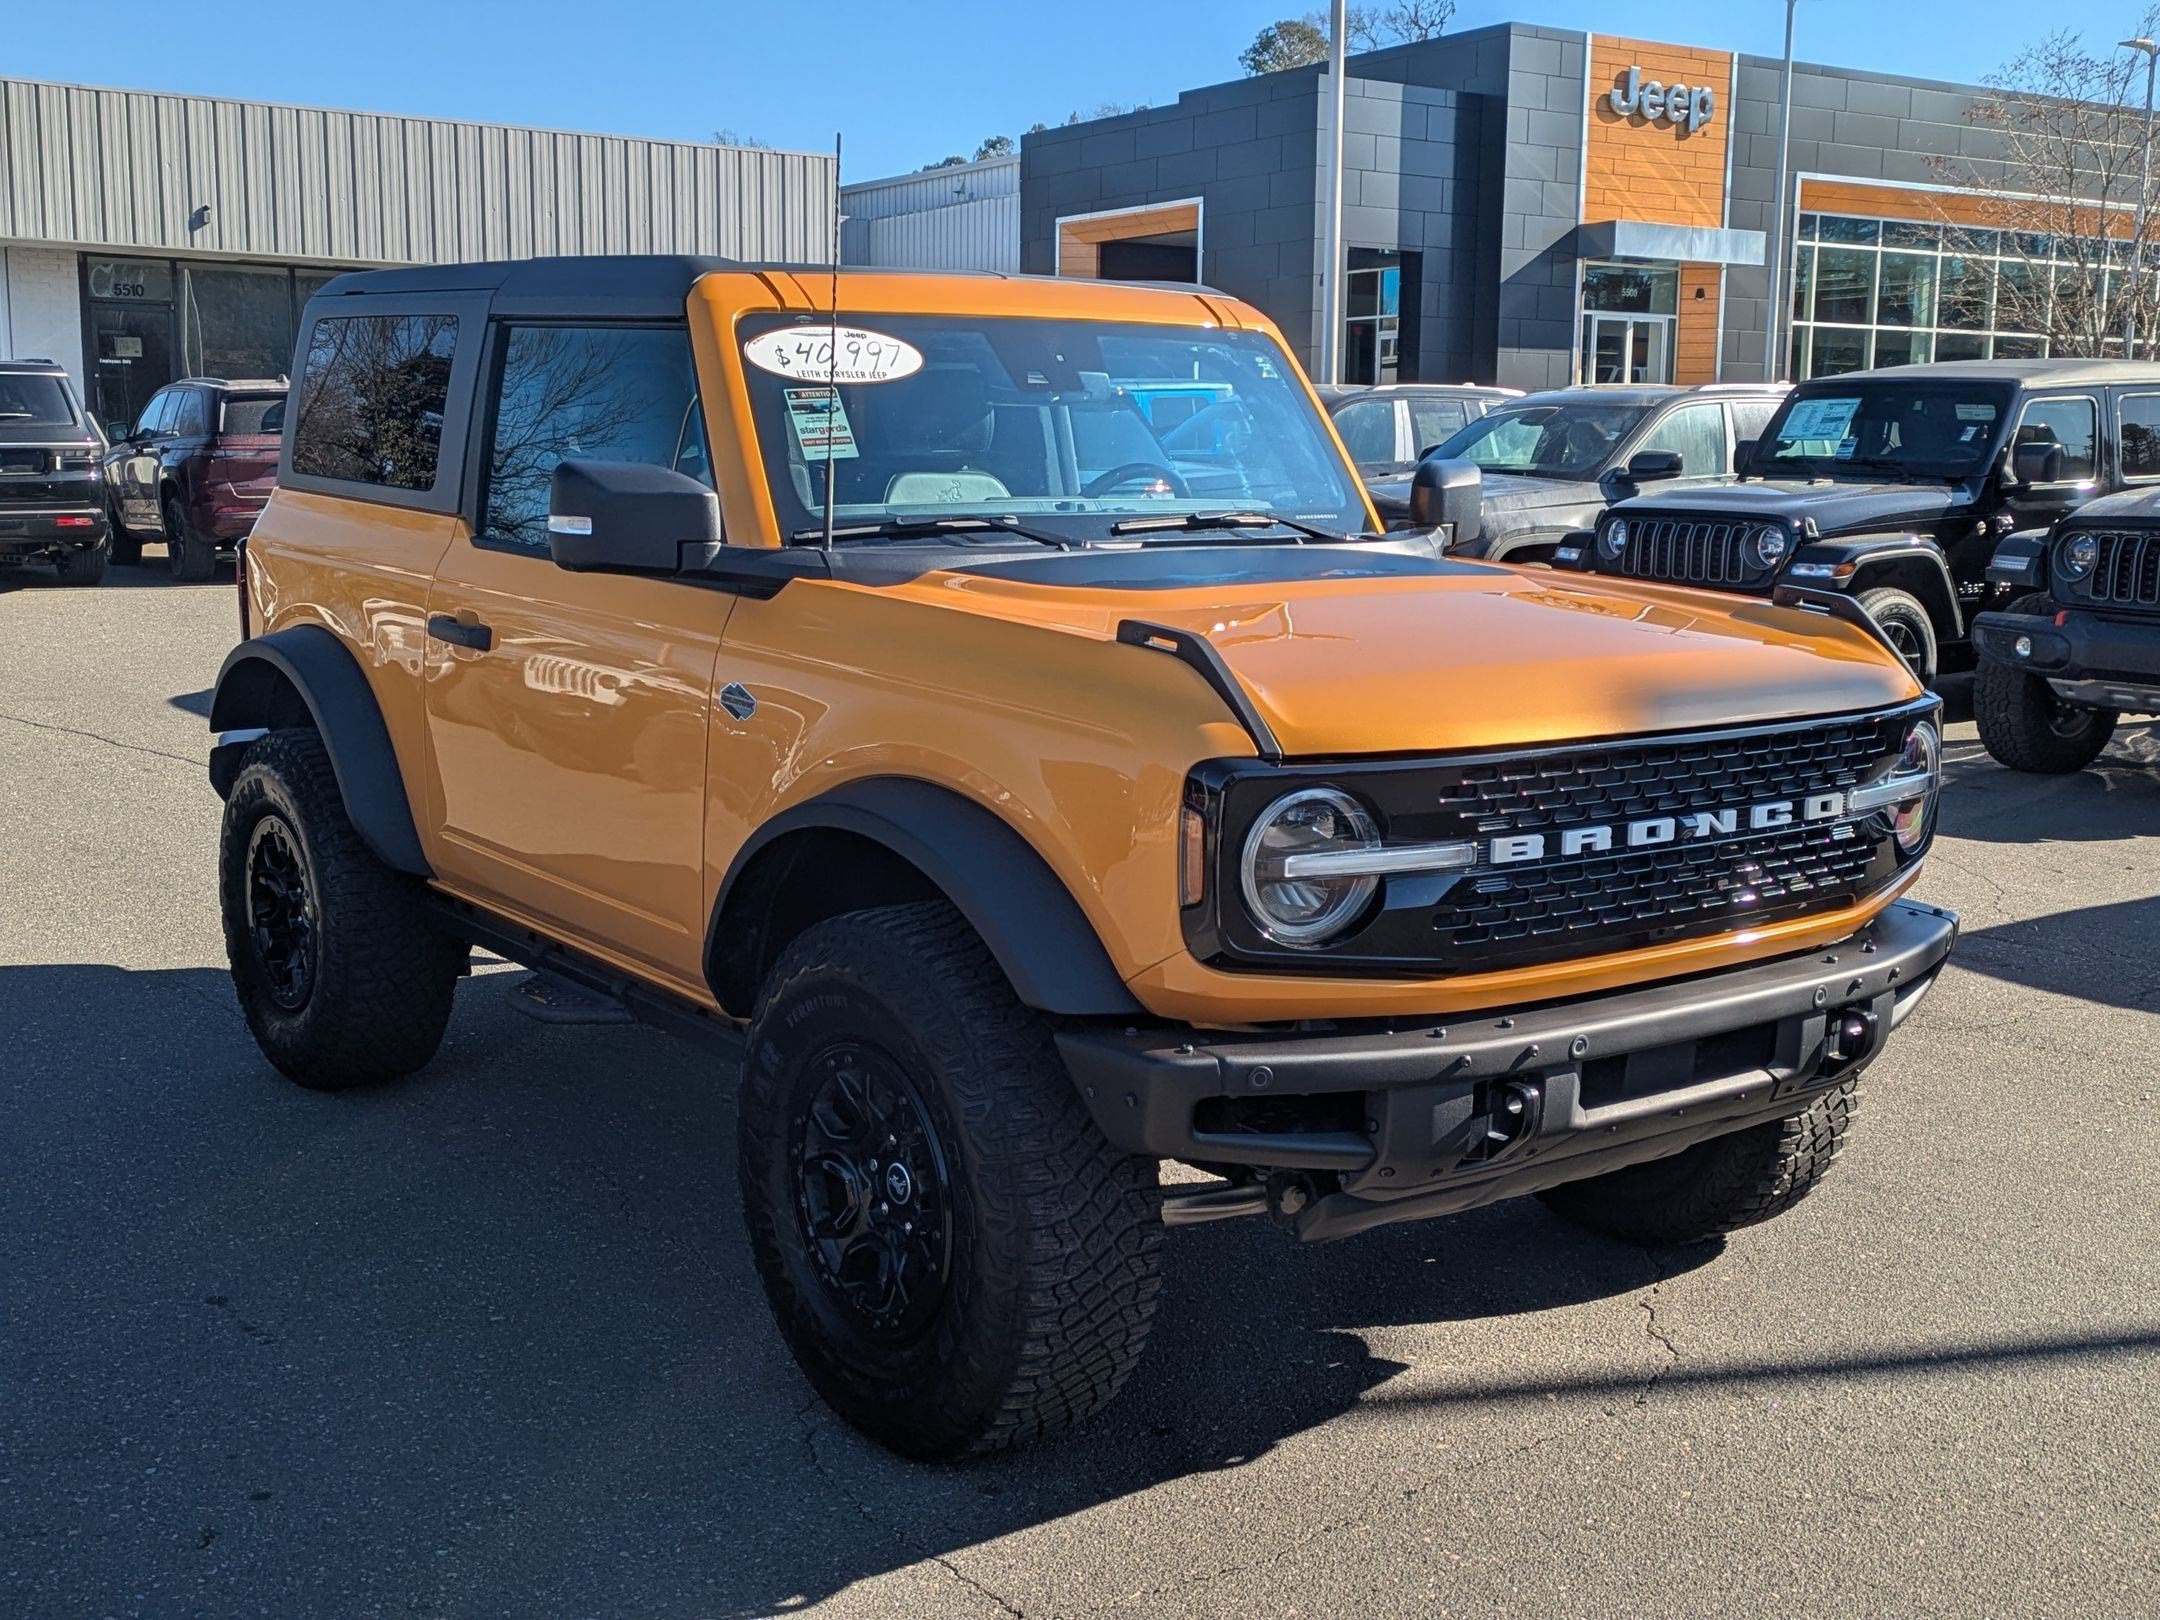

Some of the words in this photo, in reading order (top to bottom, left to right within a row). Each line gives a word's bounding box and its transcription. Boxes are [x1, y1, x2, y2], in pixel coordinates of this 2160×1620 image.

[1610, 66, 1714, 133] Jeep
[114, 284, 144, 297] 5510
[844, 331, 867, 340] Jeep
[797, 370, 821, 379] LEITH
[869, 371, 888, 379] JEEP
[1489, 792, 1844, 864] BRONCO
